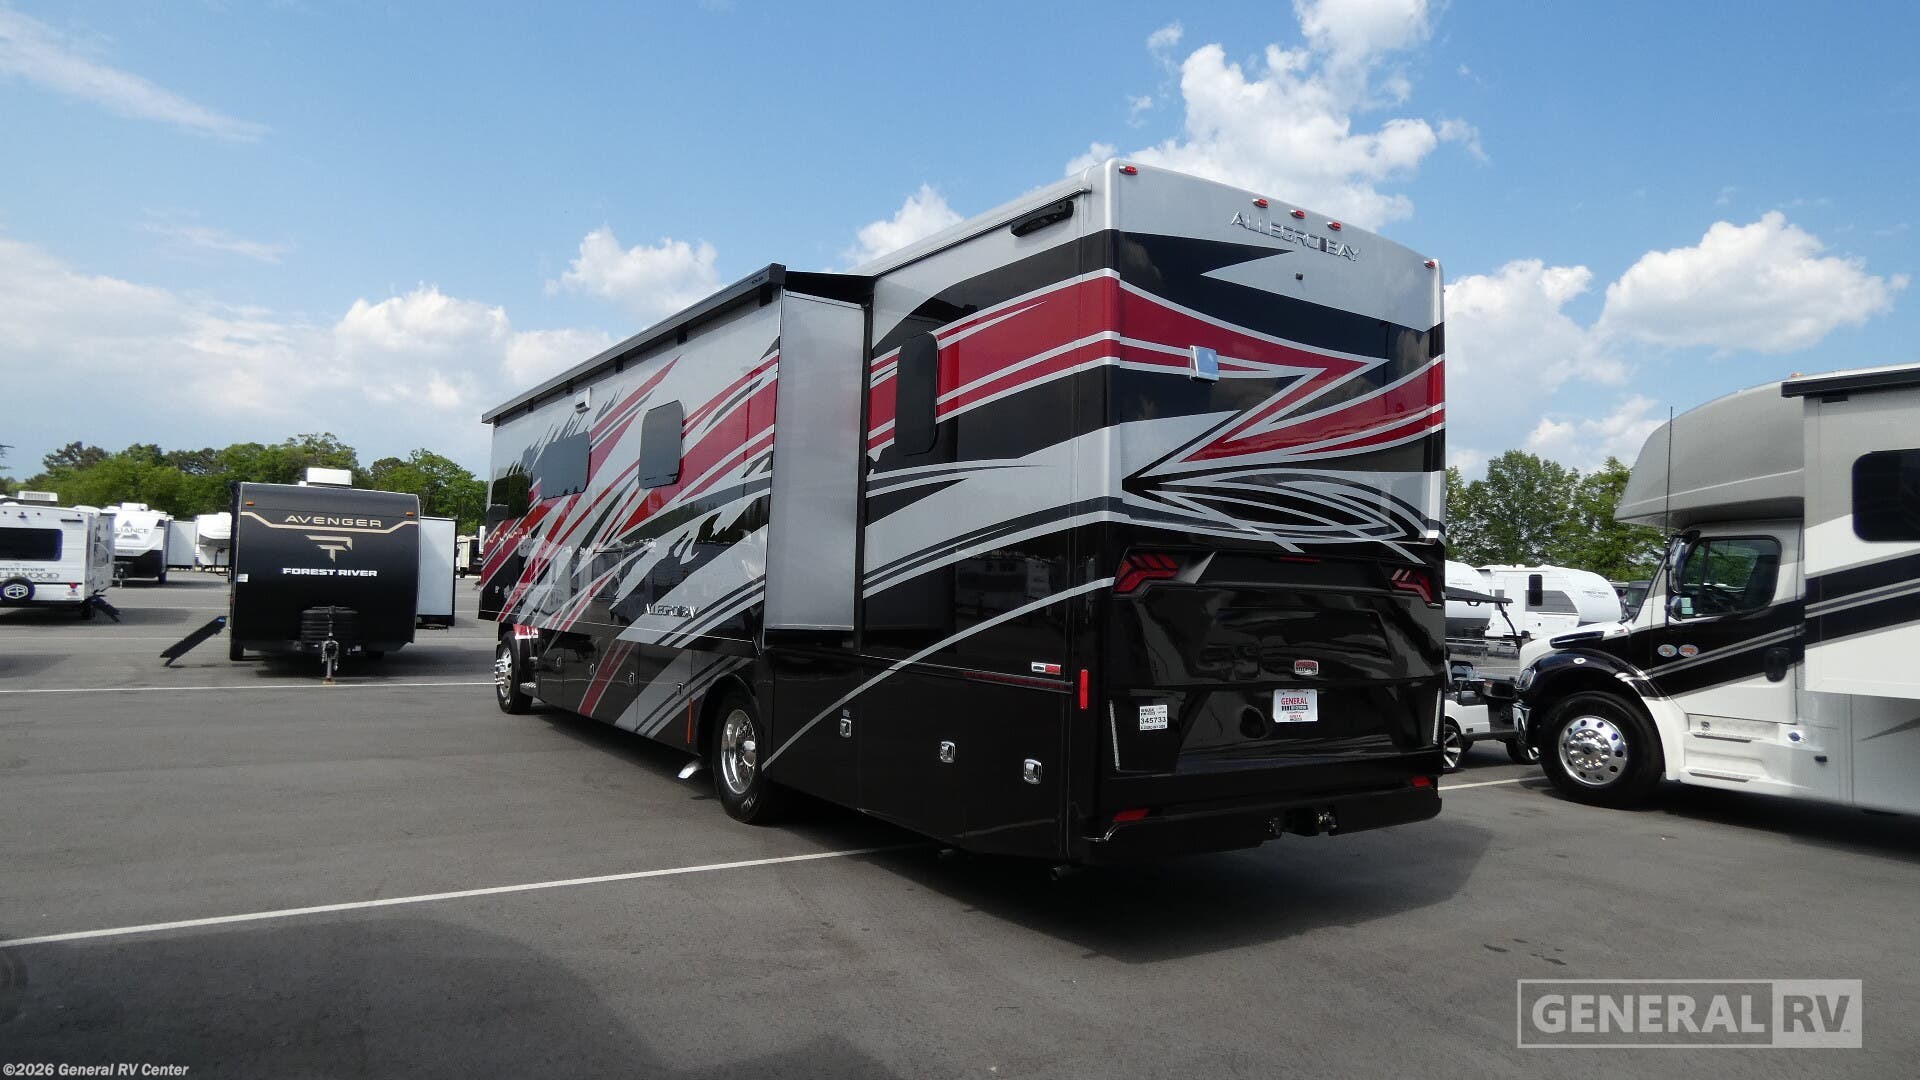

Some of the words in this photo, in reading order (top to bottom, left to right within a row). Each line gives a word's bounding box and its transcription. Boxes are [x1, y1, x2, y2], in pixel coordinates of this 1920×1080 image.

[1231, 211, 1320, 250] ALLEGRO
[1320, 236, 1360, 261] BAY
[285, 515, 382, 527] AVENGER
[282, 567, 336, 576] FOREST
[1280, 697, 1308, 705] GENERAL
